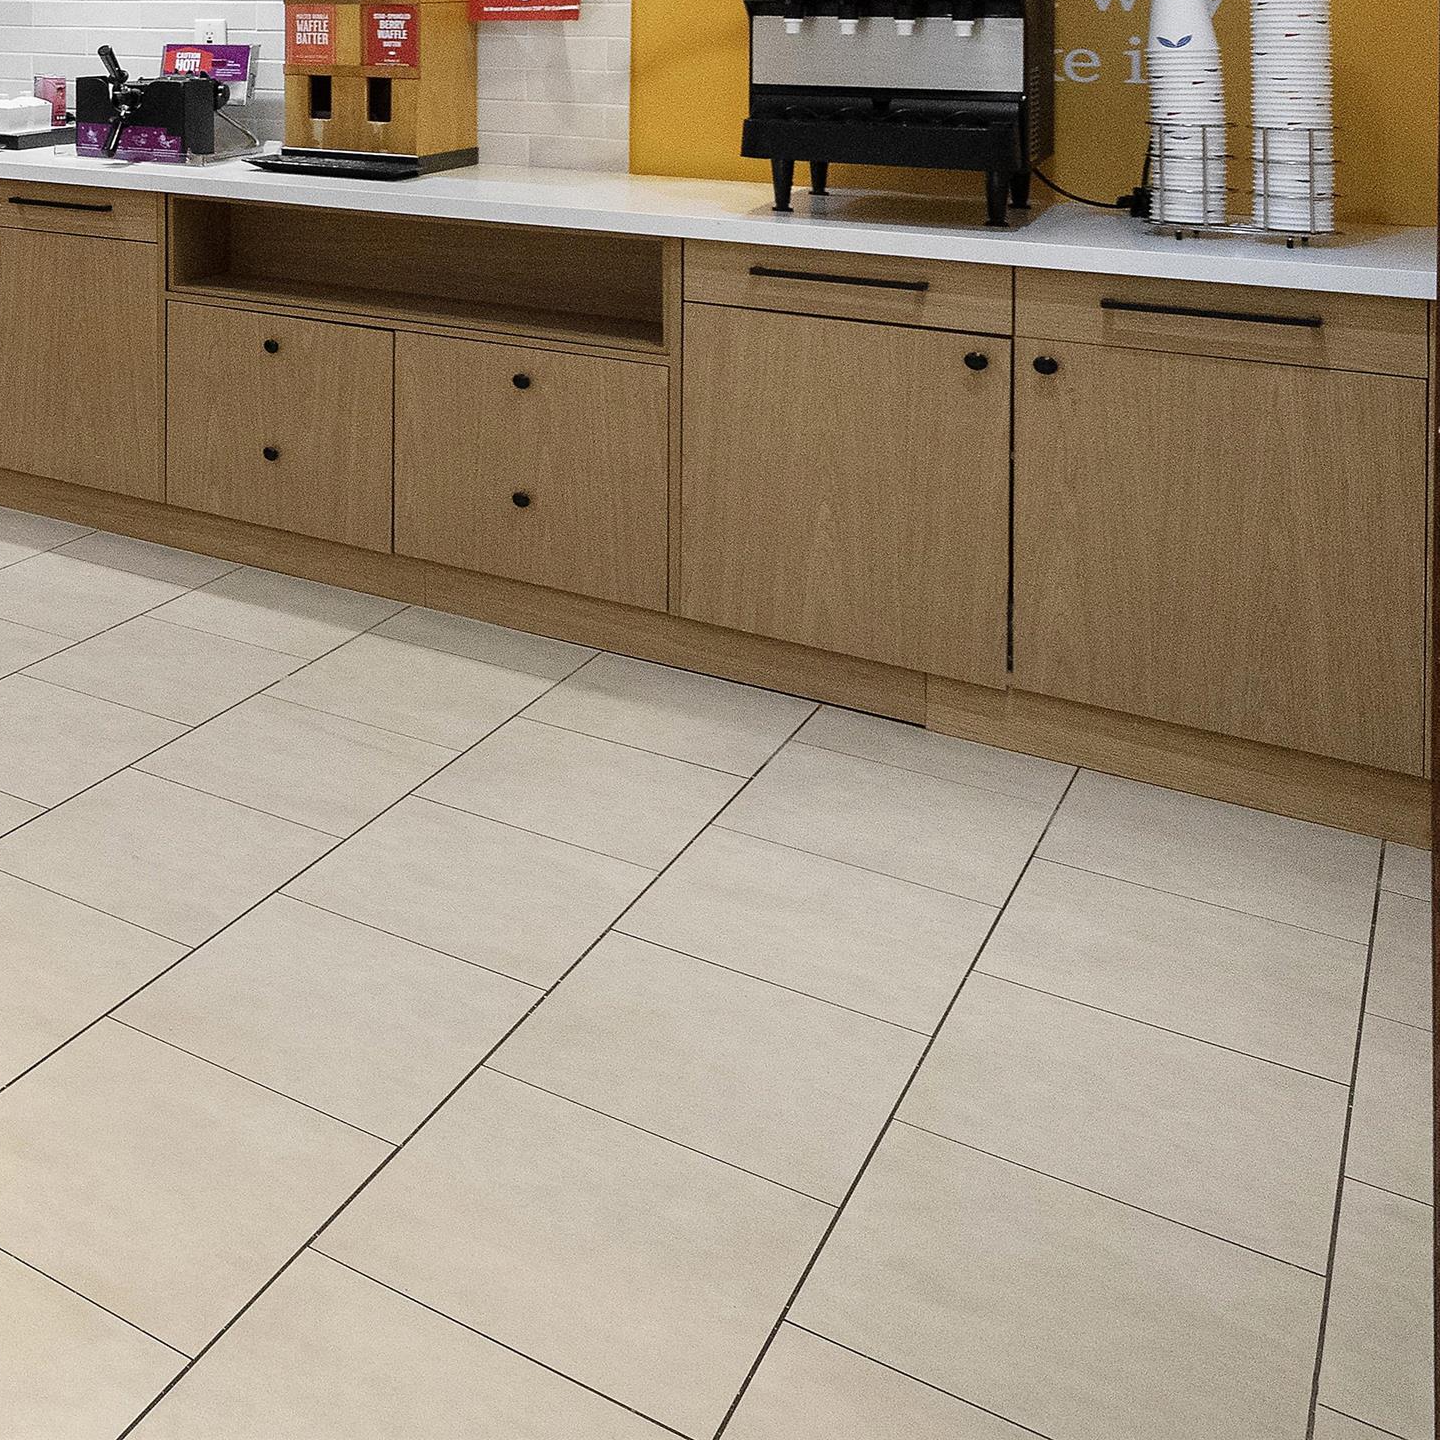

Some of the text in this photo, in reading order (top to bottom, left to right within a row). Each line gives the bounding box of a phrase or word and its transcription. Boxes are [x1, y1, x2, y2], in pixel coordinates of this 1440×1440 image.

[296, 20, 329, 33] WAFFLE
[379, 20, 406, 30] BERRY
[295, 33, 329, 45] BATTER
[377, 29, 408, 40] WAFFLE
[174, 58, 201, 72] HOT!
